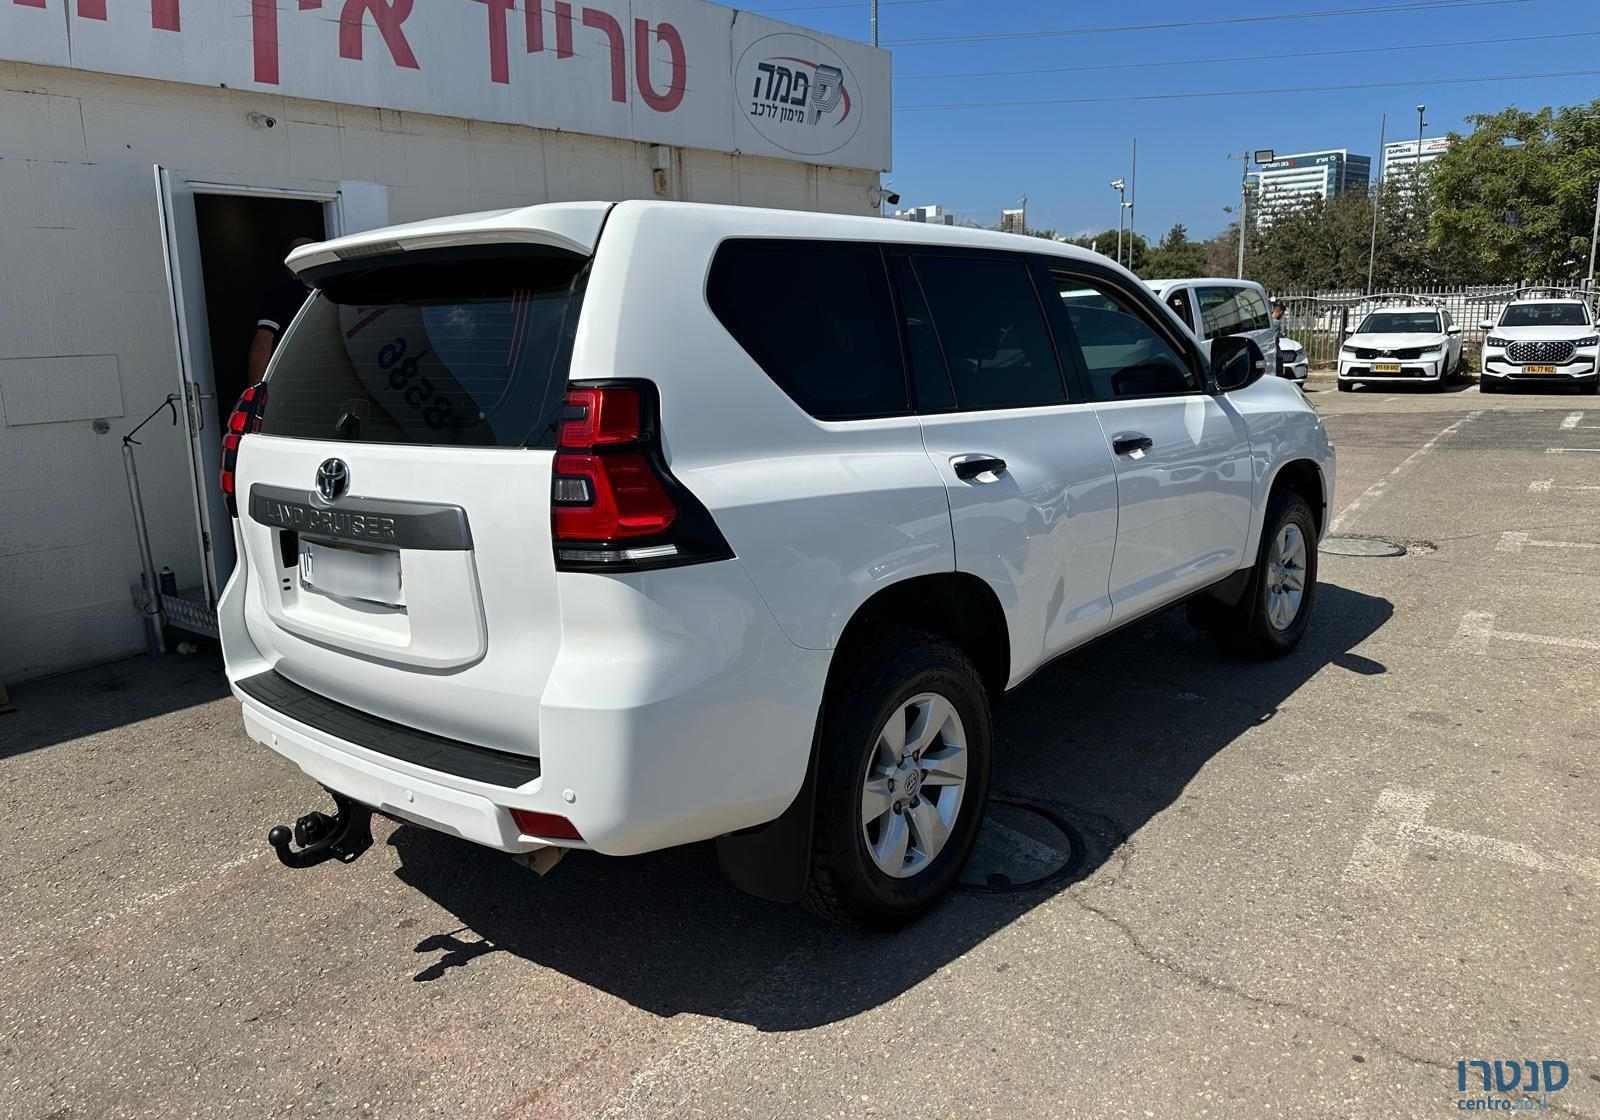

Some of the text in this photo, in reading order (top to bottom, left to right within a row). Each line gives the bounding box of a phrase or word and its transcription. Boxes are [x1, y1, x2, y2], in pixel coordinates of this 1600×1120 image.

[753, 62, 809, 106] פמה
[751, 102, 805, 123] מימון לרכב
[1387, 147, 1411, 155] SAPIENS
[266, 501, 396, 539] LAND CRUISER
